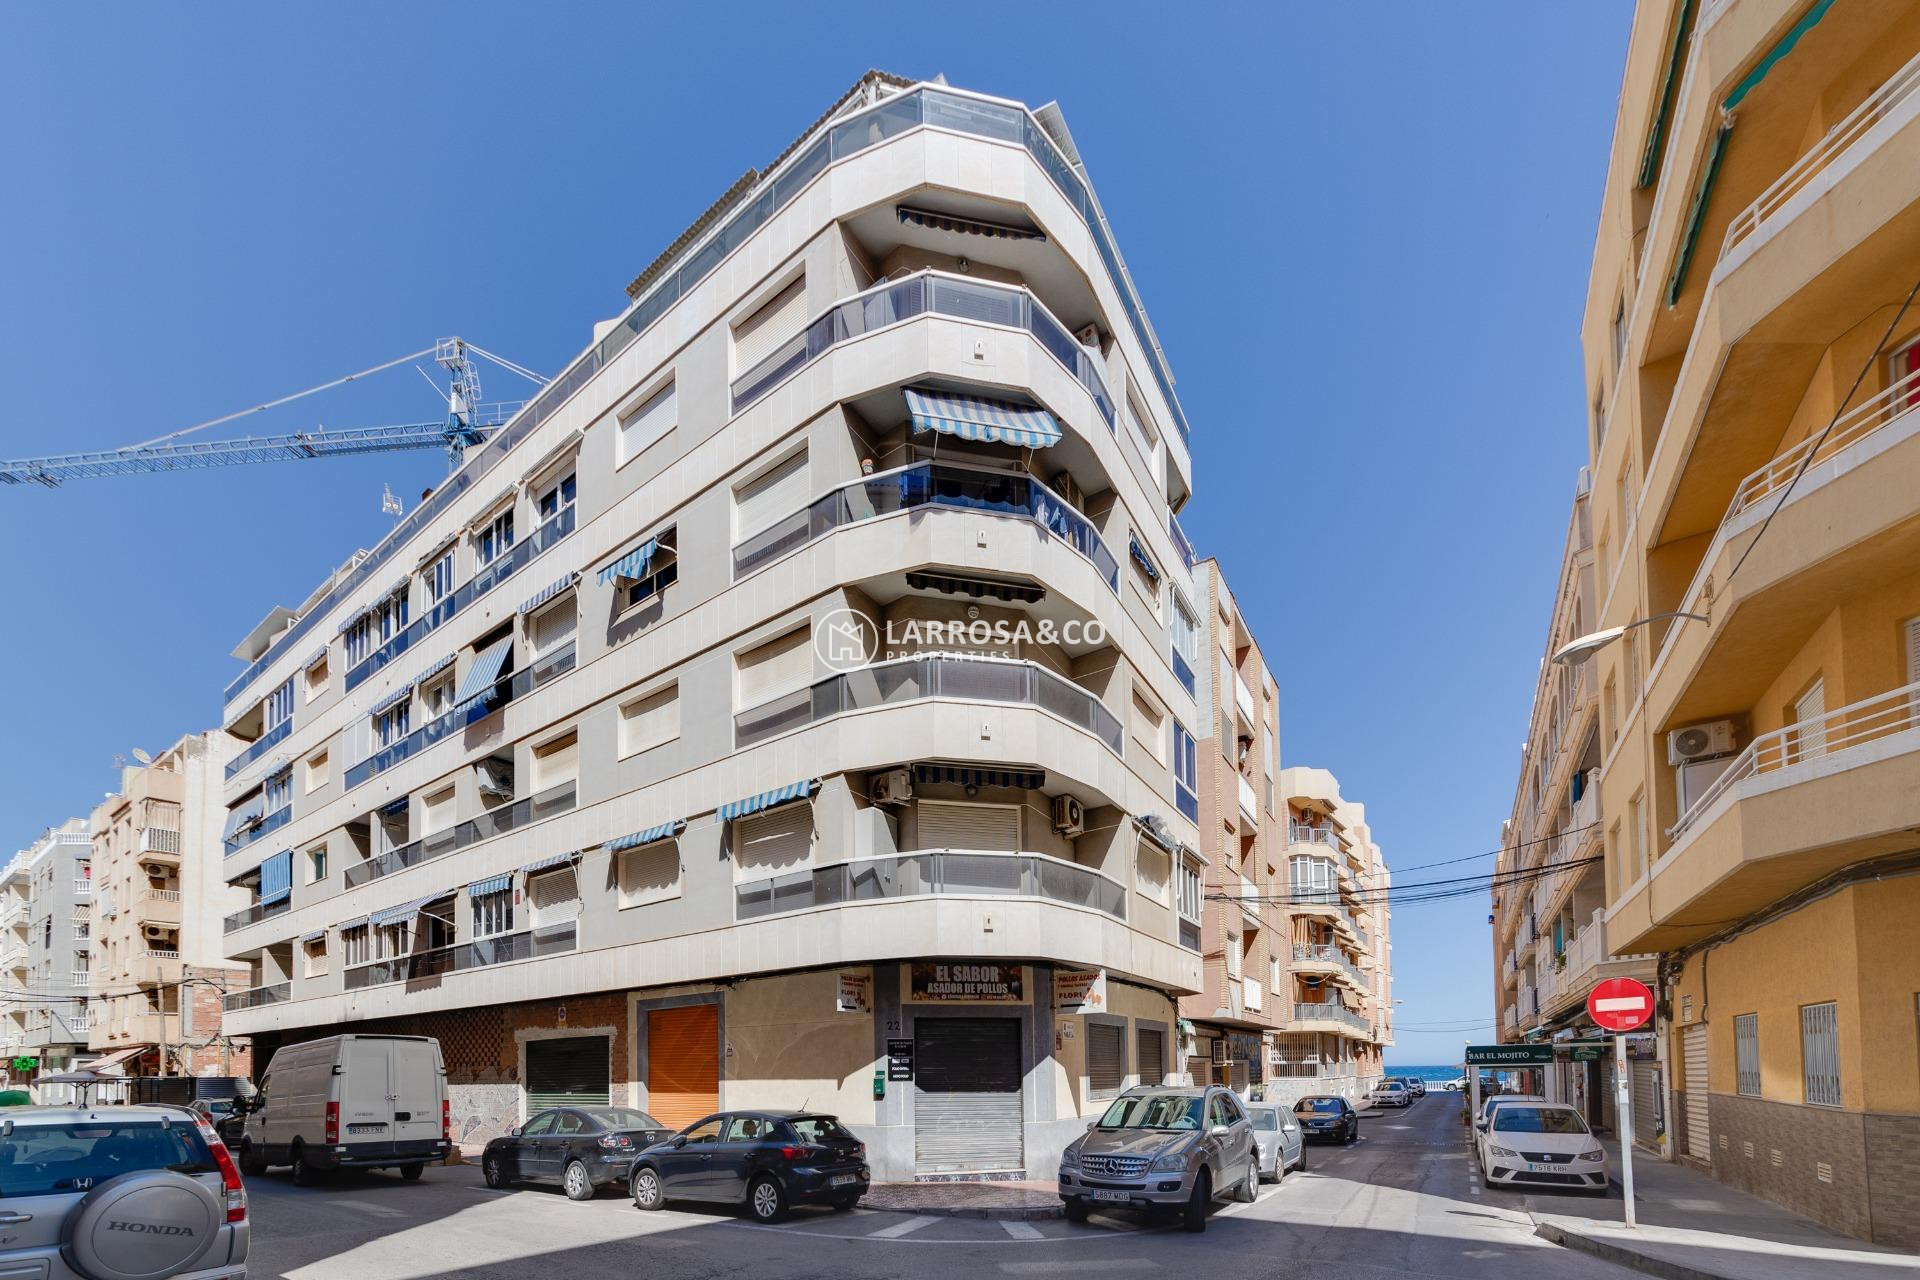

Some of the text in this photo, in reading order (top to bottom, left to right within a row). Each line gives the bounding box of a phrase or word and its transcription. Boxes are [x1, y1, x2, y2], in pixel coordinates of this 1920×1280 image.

[936, 965, 999, 982] EL SABOR
[927, 982, 1008, 994] ASADOR DE POLLOS
[887, 1020, 900, 1031] 22
[1497, 1051, 1530, 1059] MOJITO
[106, 1221, 195, 1237] HONDA
